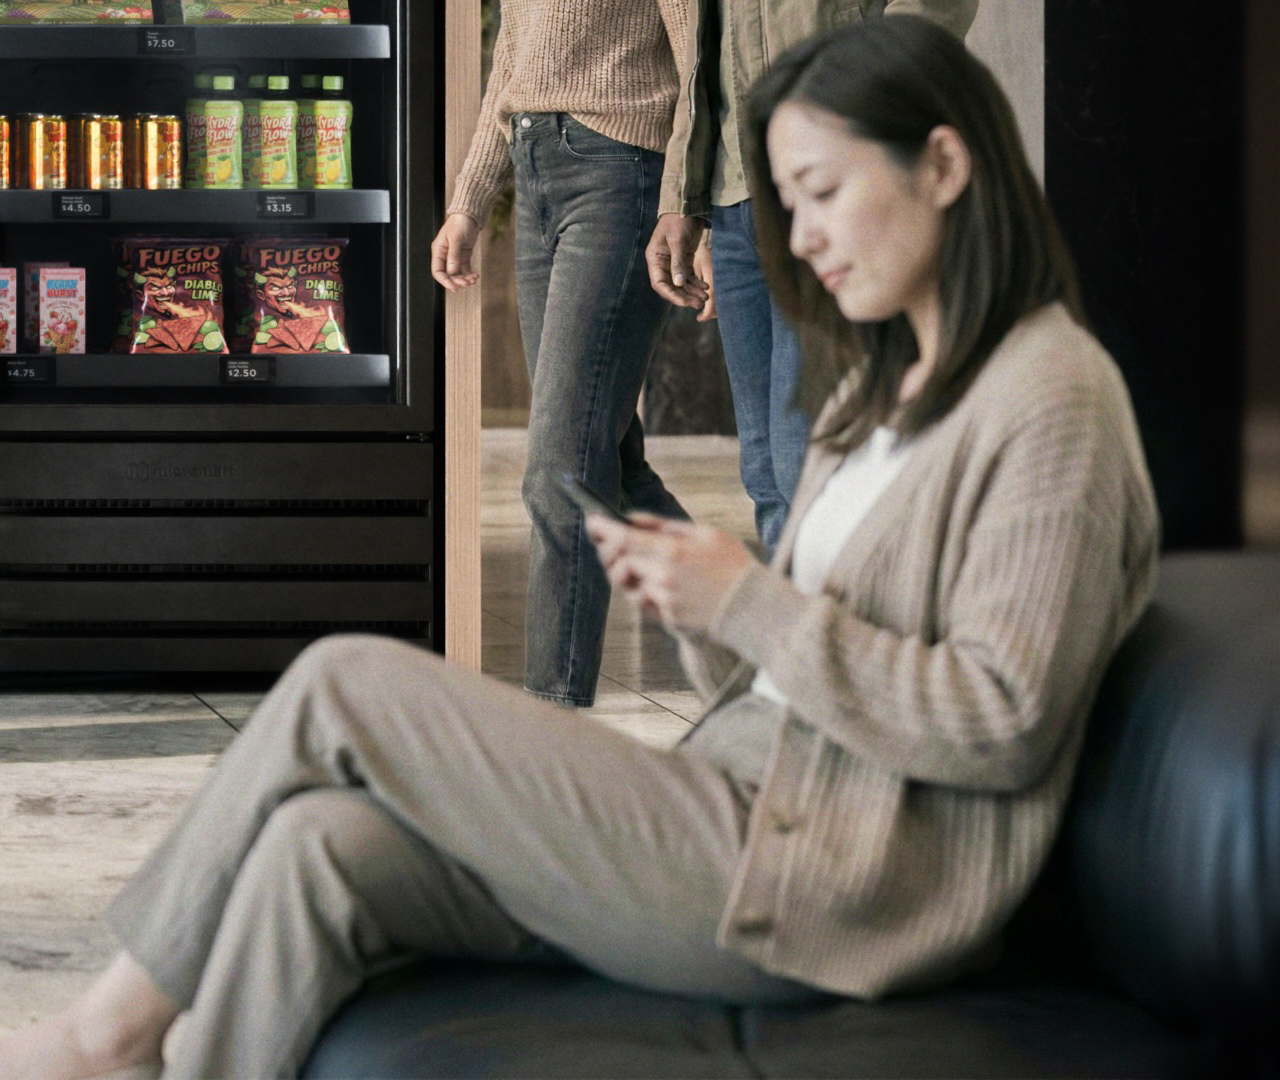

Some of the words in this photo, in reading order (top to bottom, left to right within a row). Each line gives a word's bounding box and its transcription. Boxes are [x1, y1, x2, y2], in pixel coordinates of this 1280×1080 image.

[62, 204, 90, 212] $4.50
[267, 204, 291, 212] $3.15
[139, 246, 220, 268] FUEGO
[259, 246, 341, 268] FUEGO
[177, 262, 219, 275] CHIPS
[297, 262, 339, 275] CHIPS
[184, 280, 223, 293] DIABLO
[305, 280, 344, 293] DIABLO
[47, 289, 77, 298] BURST
[192, 290, 219, 301] LIME
[312, 290, 340, 301] LIME
[8, 369, 35, 377] $4.75
[228, 369, 257, 377] $2.50
